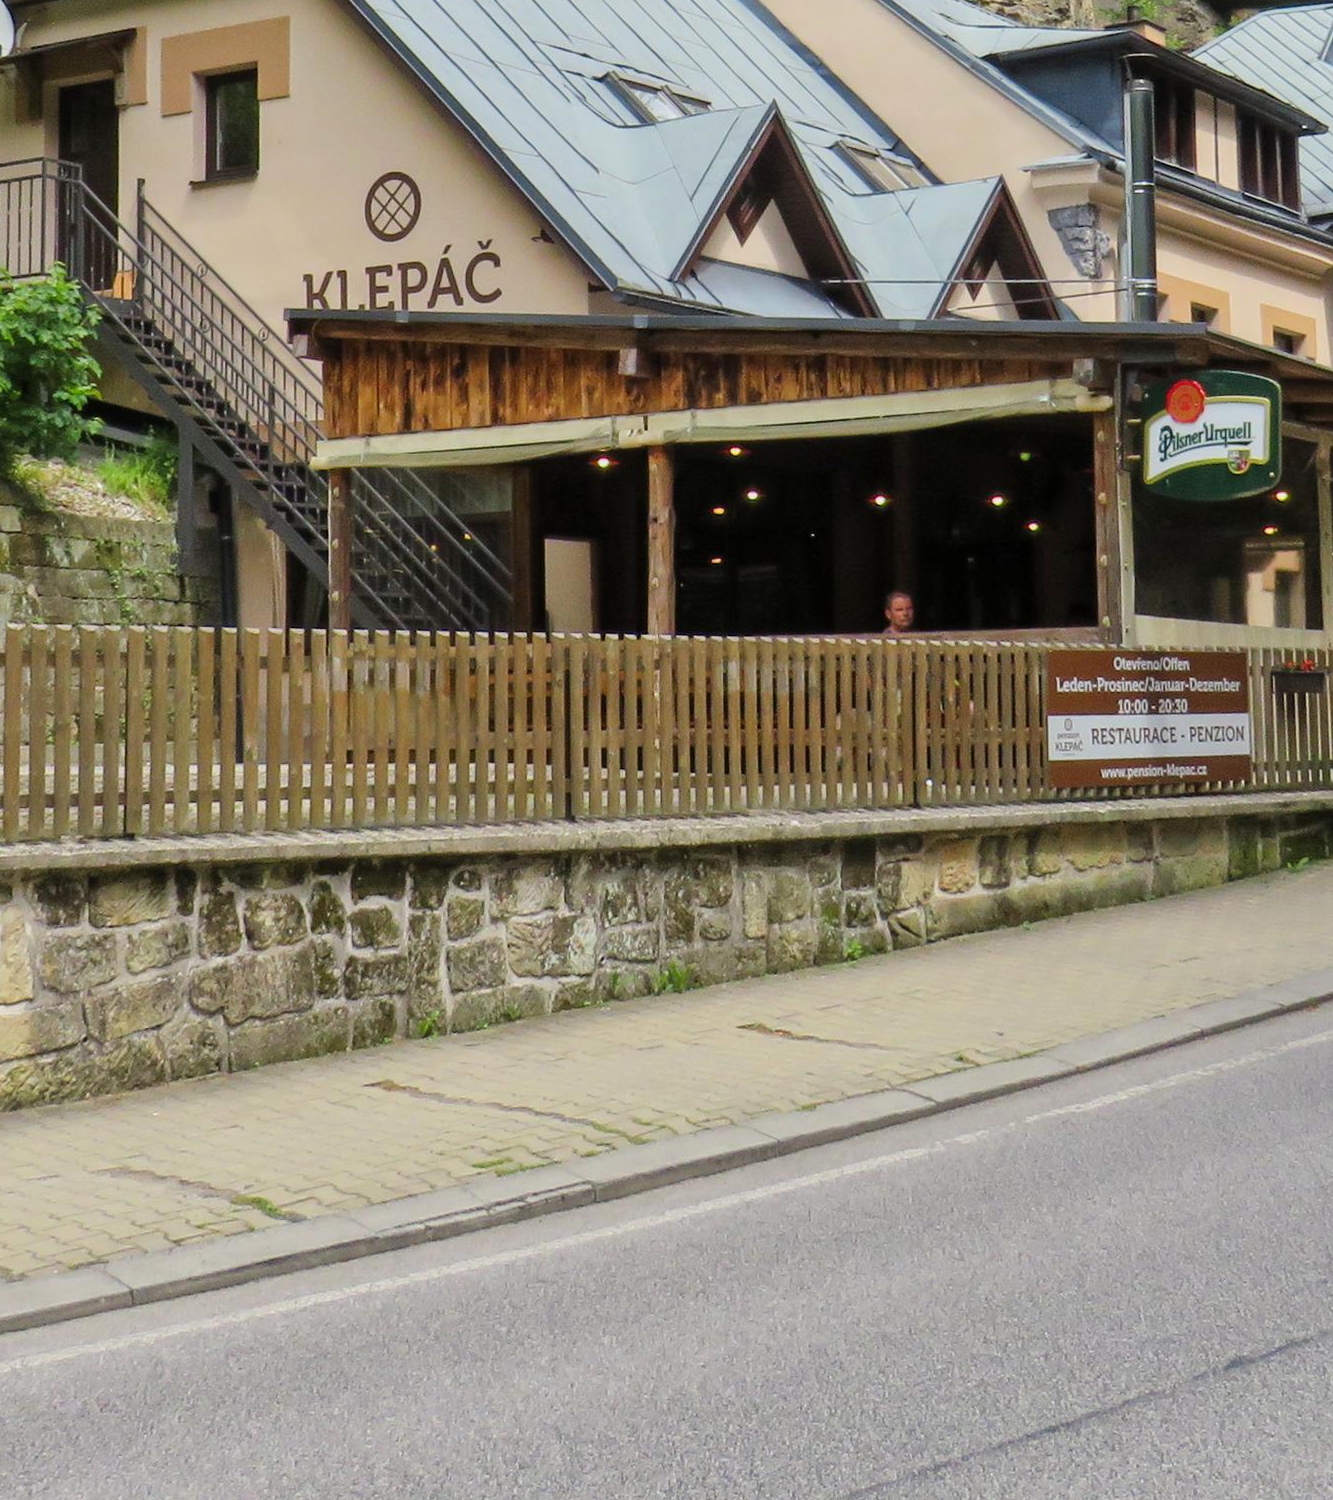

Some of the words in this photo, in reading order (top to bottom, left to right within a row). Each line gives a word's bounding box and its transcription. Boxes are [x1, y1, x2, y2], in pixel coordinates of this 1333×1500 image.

[302, 239, 503, 311] KLEPÁČ
[1158, 425, 1203, 463] Pilsner
[1203, 421, 1251, 448] Urquell
[1117, 699, 1148, 714] 10:00
[1158, 699, 1188, 714] 20:30
[1091, 726, 1177, 745] RESTAURACE
[1189, 725, 1245, 743] PENZION
[1100, 763, 1208, 779] www.pension-klepac.cz
